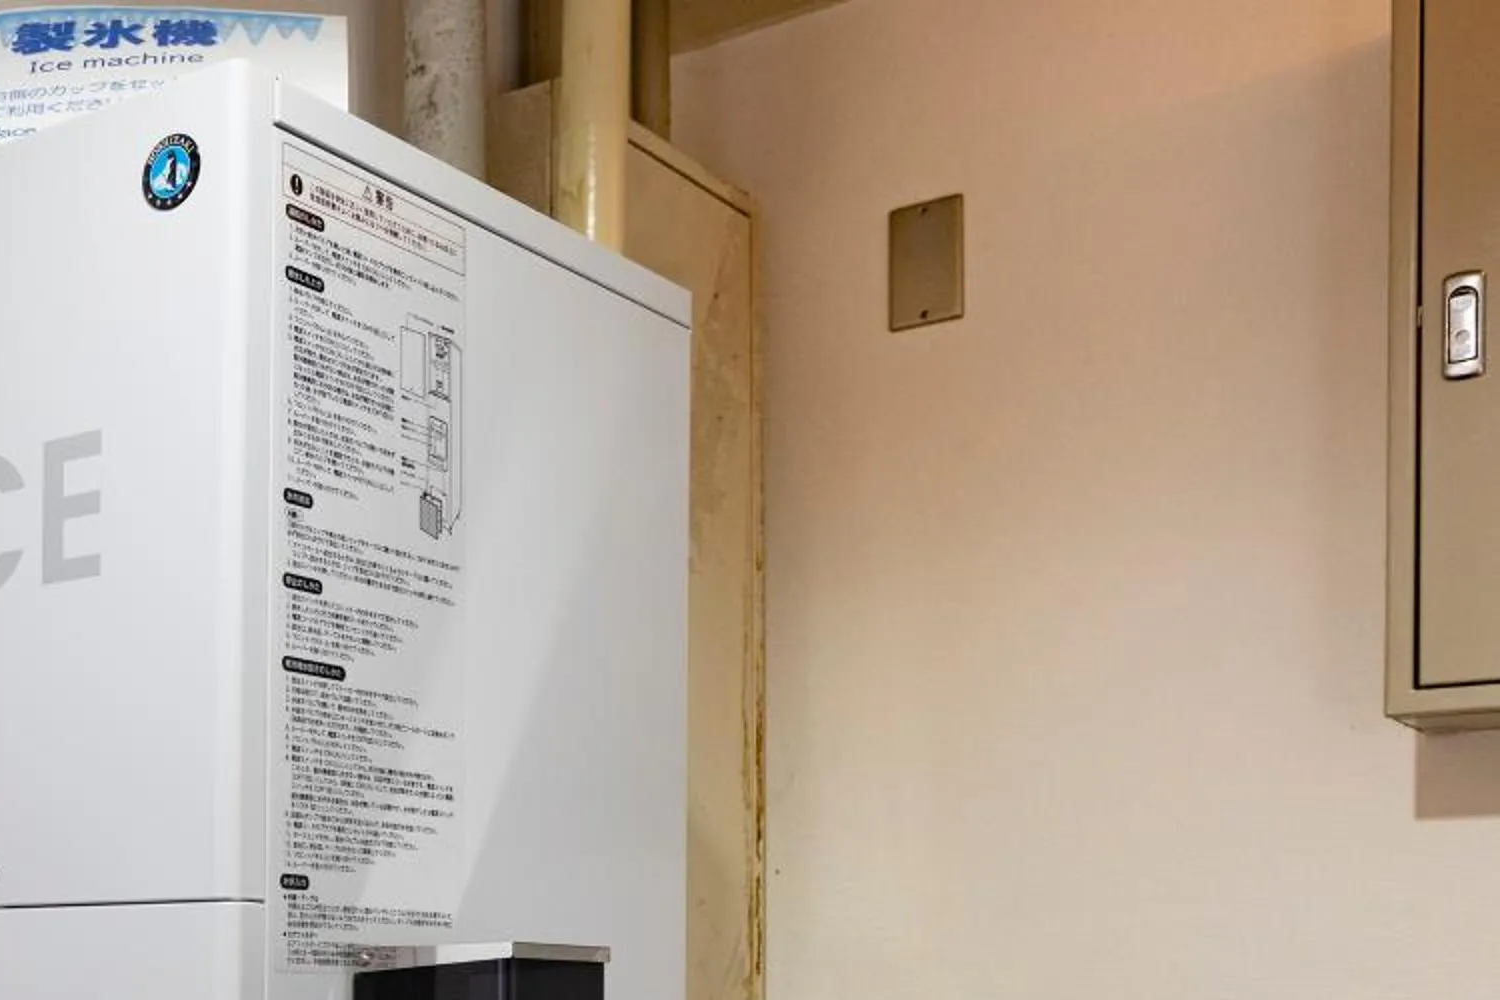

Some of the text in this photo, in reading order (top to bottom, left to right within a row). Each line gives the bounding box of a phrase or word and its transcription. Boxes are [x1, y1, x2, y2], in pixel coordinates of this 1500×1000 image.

[11, 19, 218, 55] 製氷機
[30, 52, 205, 75] Ice machine
